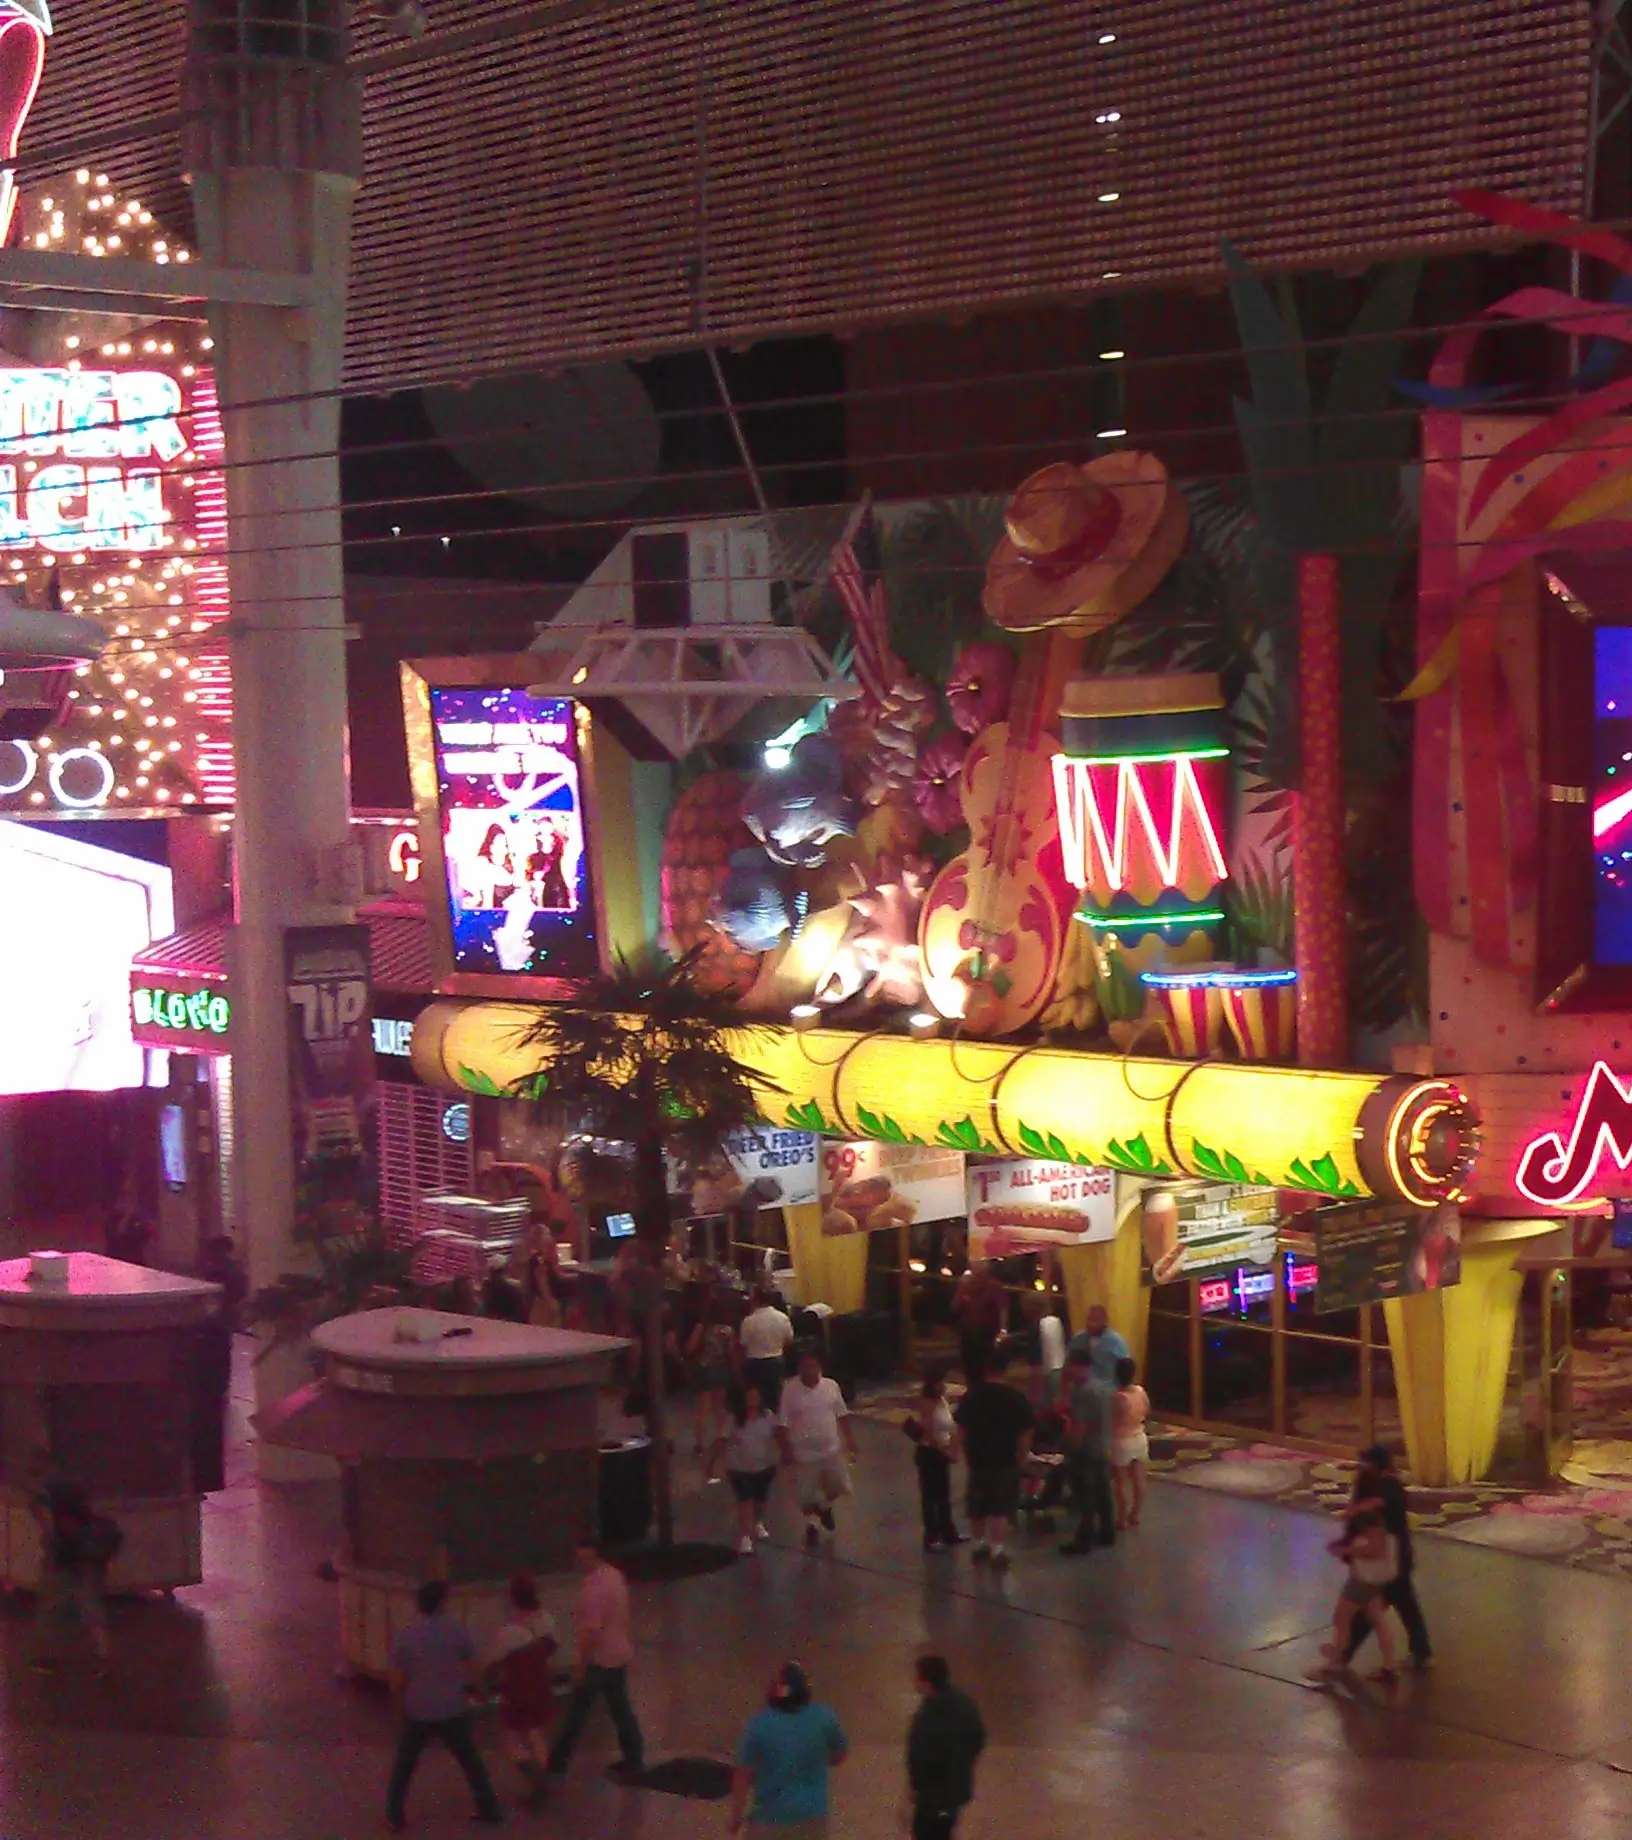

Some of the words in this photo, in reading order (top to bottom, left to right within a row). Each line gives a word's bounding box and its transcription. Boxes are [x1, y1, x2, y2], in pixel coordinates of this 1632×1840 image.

[759, 1147, 815, 1170] OREO'S
[1050, 1183, 1077, 1202] HOT
[1082, 1178, 1111, 1197] DOG
